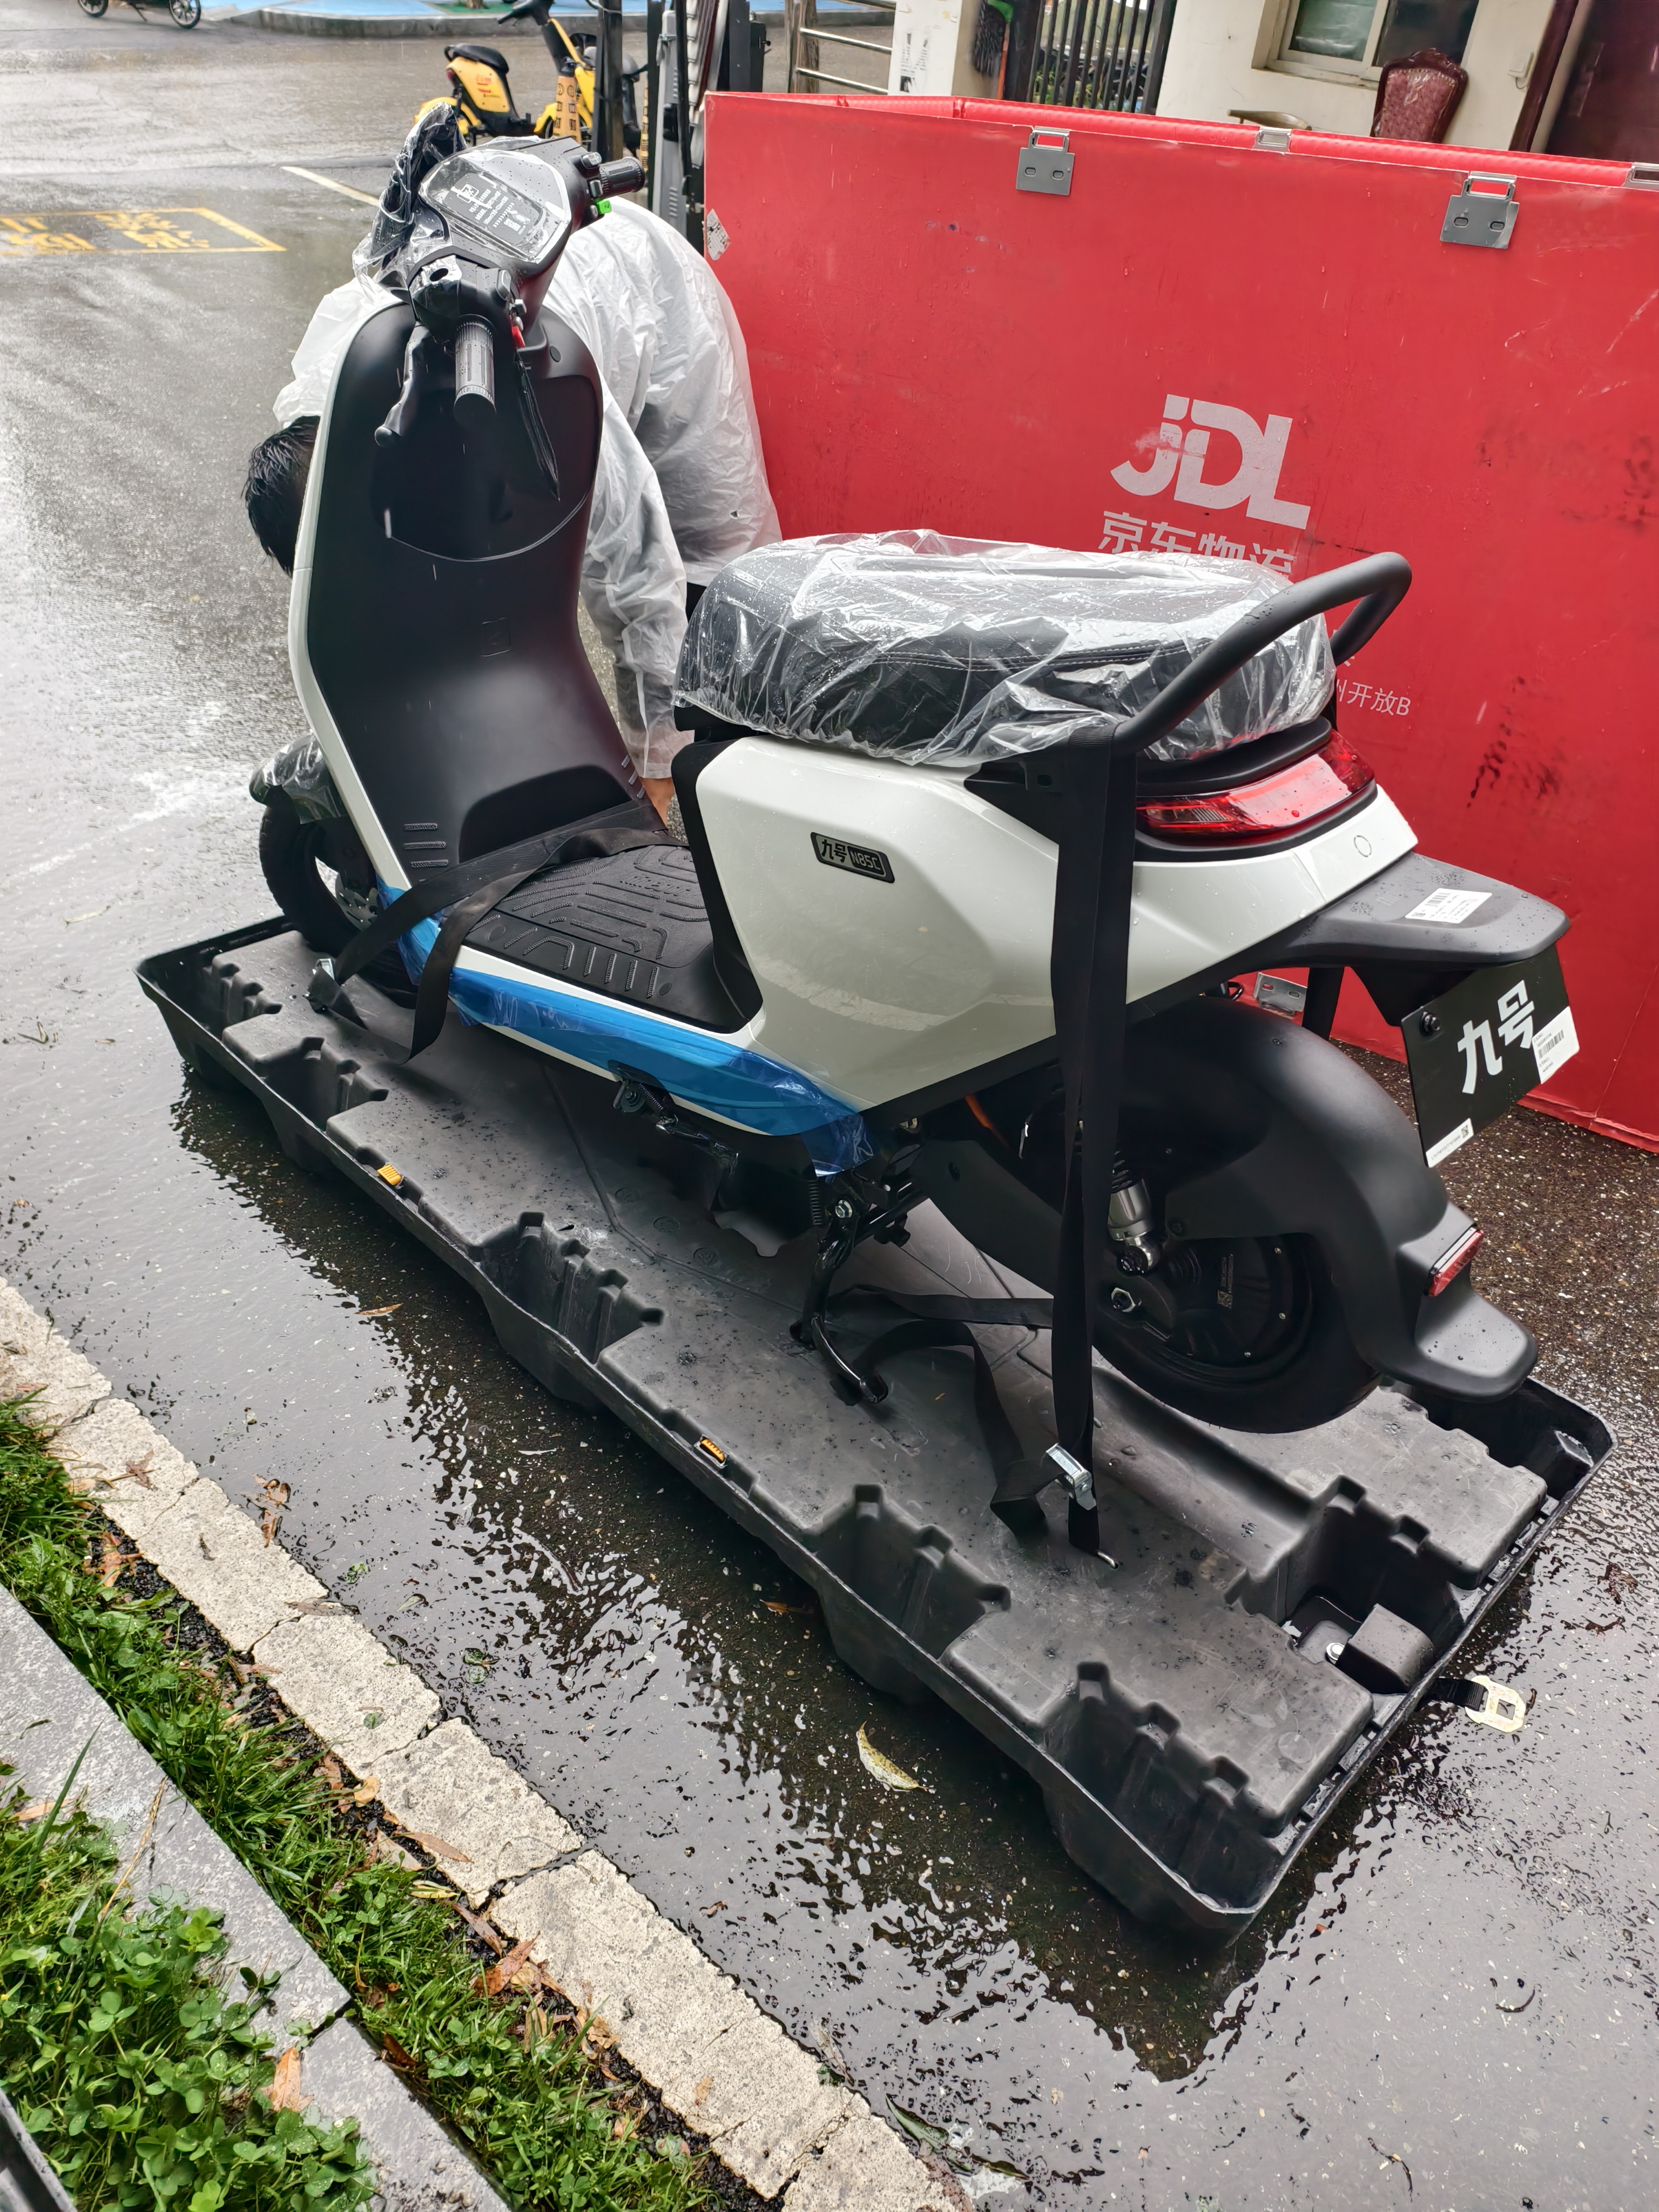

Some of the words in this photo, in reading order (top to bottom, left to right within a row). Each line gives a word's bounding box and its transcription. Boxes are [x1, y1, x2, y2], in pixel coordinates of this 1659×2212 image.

[1110, 394, 1311, 530] JDL
[821, 839, 847, 863] 九号
[850, 851, 881, 871] N85C
[1457, 979, 1535, 1095] 九号
